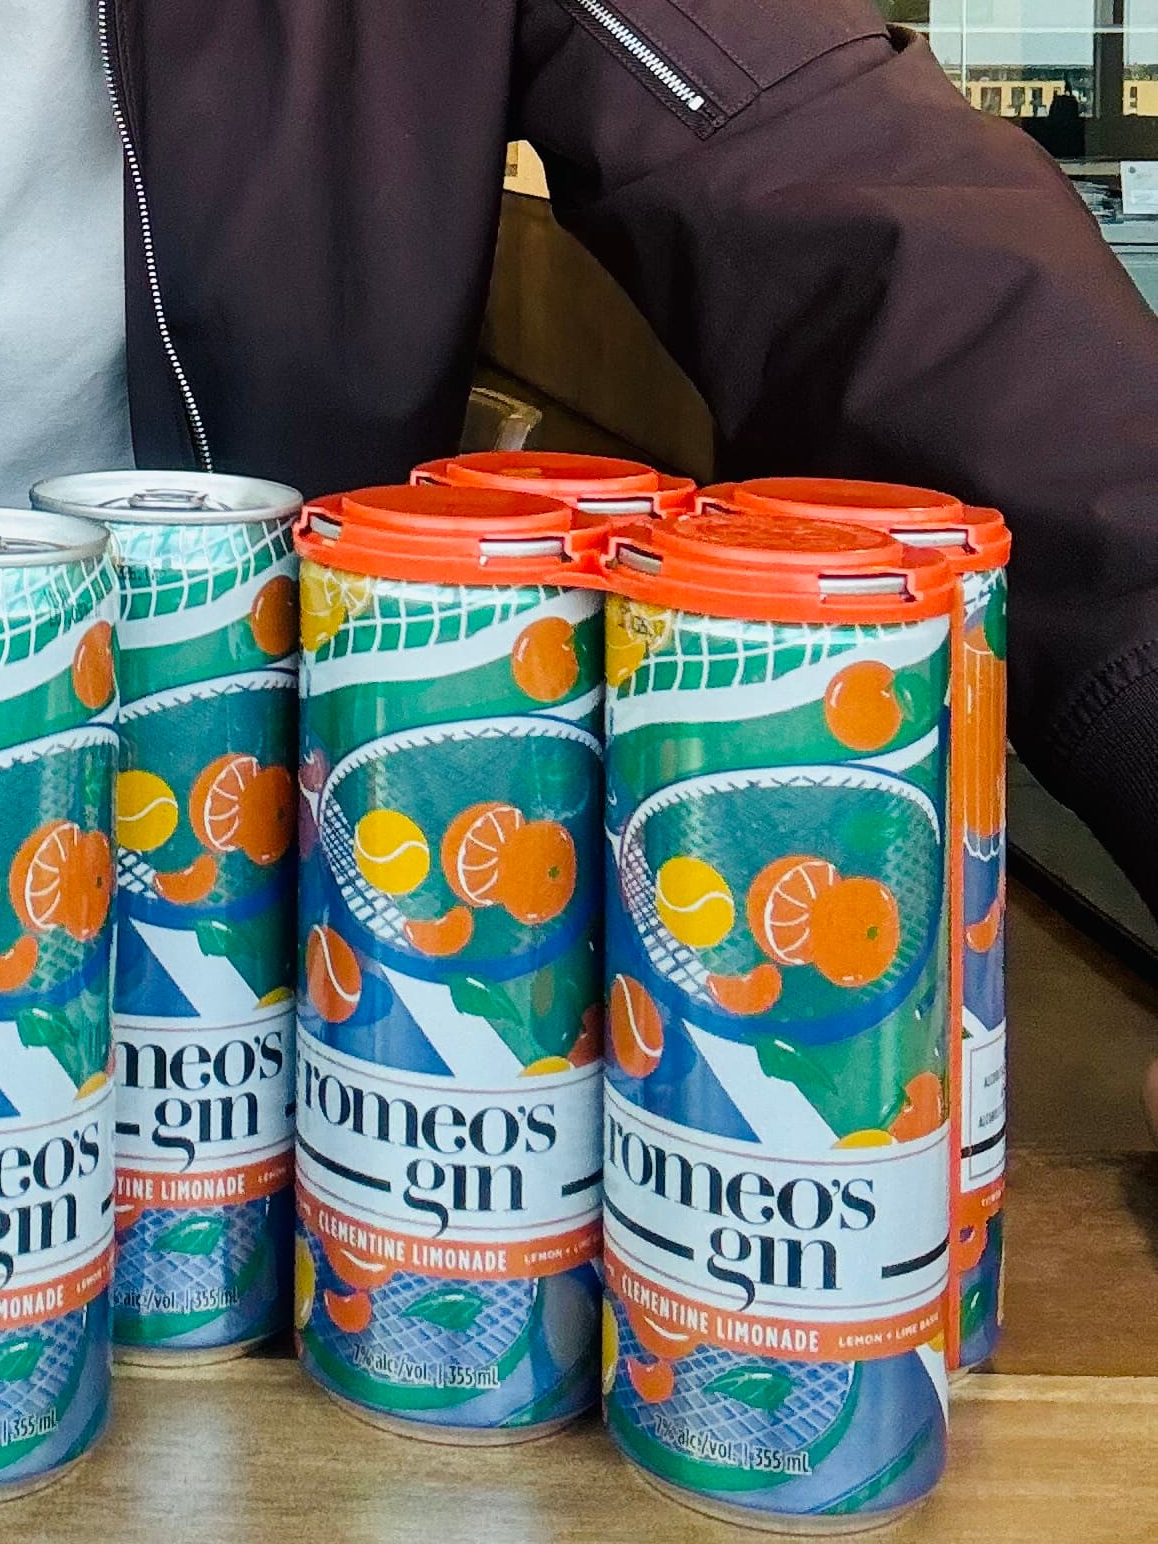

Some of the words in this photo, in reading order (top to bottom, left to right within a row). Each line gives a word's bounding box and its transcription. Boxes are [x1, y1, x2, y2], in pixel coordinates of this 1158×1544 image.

[116, 1031, 283, 1091] meo's
[151, 1091, 258, 1173] gin
[303, 1058, 556, 1157] romeo's
[161, 1174, 246, 1201] LIMONADE
[403, 1158, 528, 1239] gin
[608, 1114, 877, 1231] romeo's
[318, 1210, 406, 1262] CLEMENTINE
[412, 1243, 507, 1272] LIMONADE
[707, 1226, 843, 1311] gin
[195, 1287, 218, 1308] 355
[621, 1274, 709, 1335] CLEMENTINE
[716, 1316, 820, 1353] LIMONADE
[838, 1334, 883, 1349] LEMON
[894, 1324, 919, 1340] LIME
[352, 1342, 375, 1366] 7%
[448, 1365, 473, 1386] 355
[476, 1366, 499, 1386] mL
[12, 1417, 36, 1440] 355
[39, 1407, 58, 1432] mL
[654, 1414, 676, 1440] 7%
[754, 1446, 782, 1470] 355
[785, 1449, 812, 1474] mL
